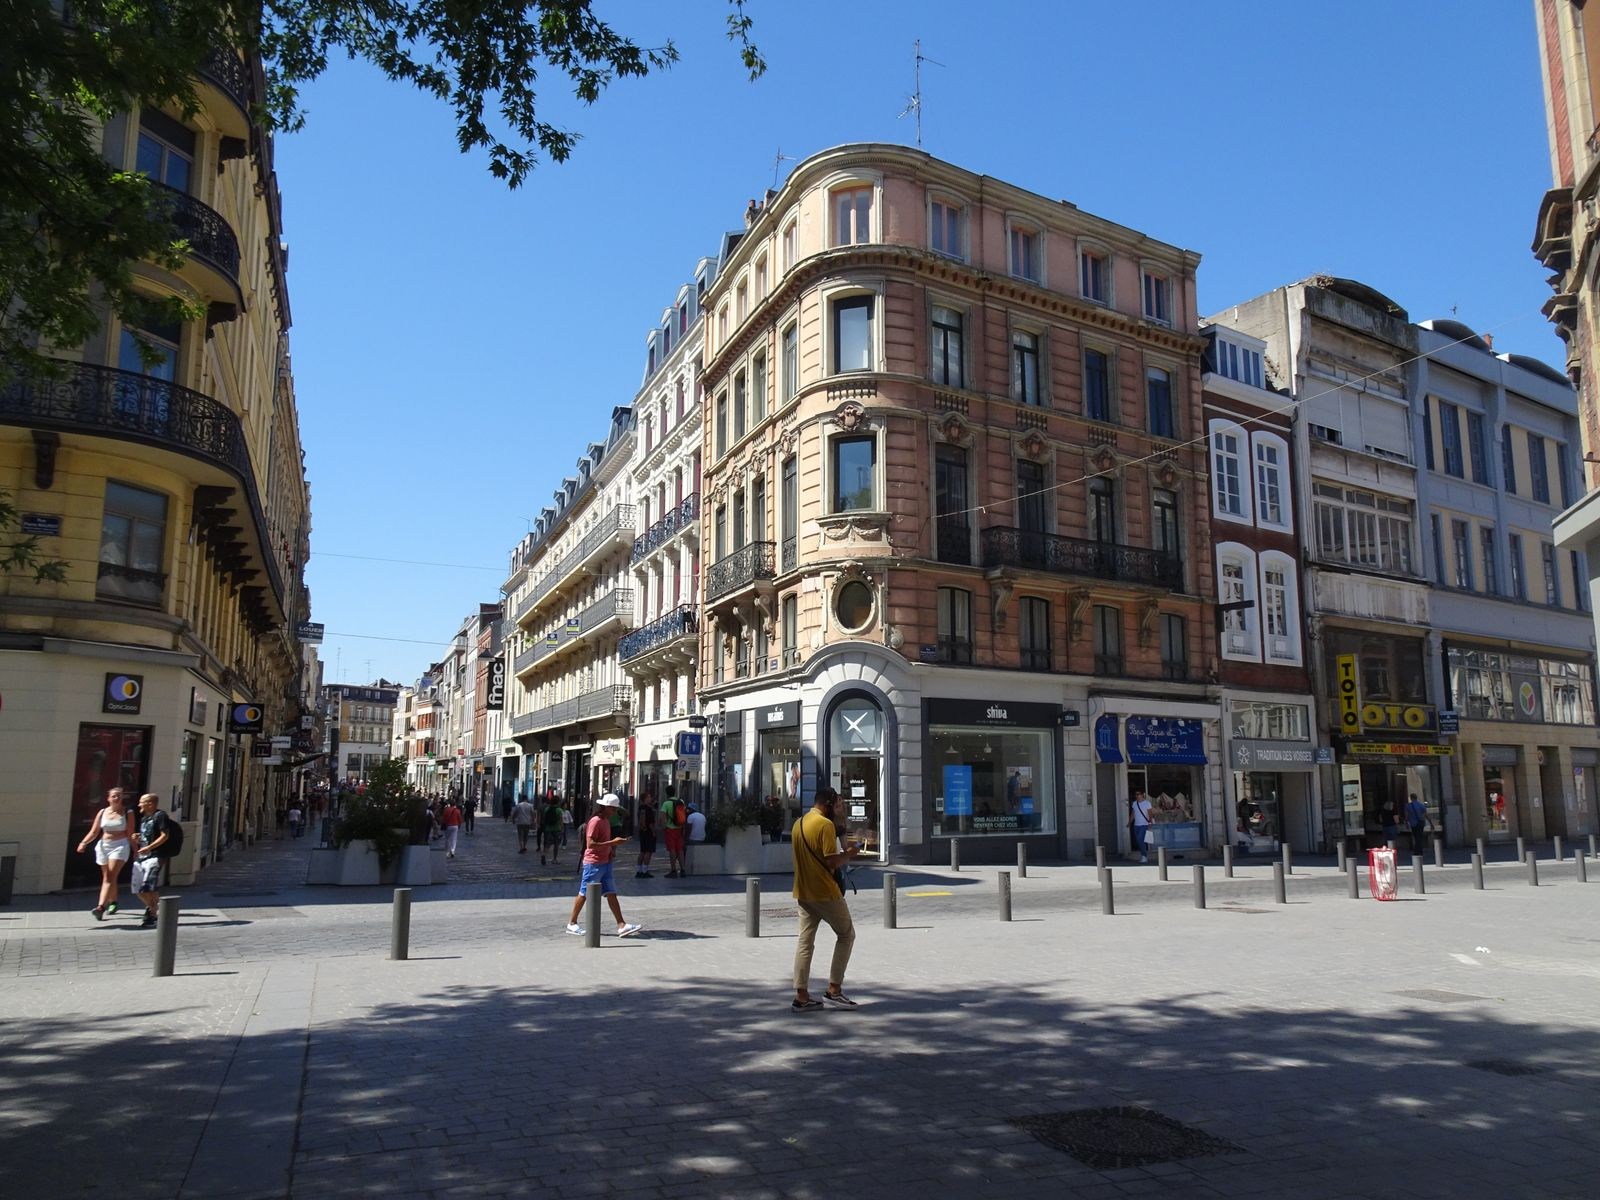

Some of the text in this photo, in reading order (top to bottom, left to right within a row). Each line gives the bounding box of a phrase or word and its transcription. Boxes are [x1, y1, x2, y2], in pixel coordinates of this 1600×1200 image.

[488, 662, 504, 705] fnac
[1341, 662, 1357, 726] TOTO
[986, 704, 1008, 719] shiva
[1362, 704, 1426, 729] OTO
[1256, 749, 1282, 761] TRADITION
[1282, 751, 1293, 761] DES
[1293, 750, 1312, 762] VOSGES
